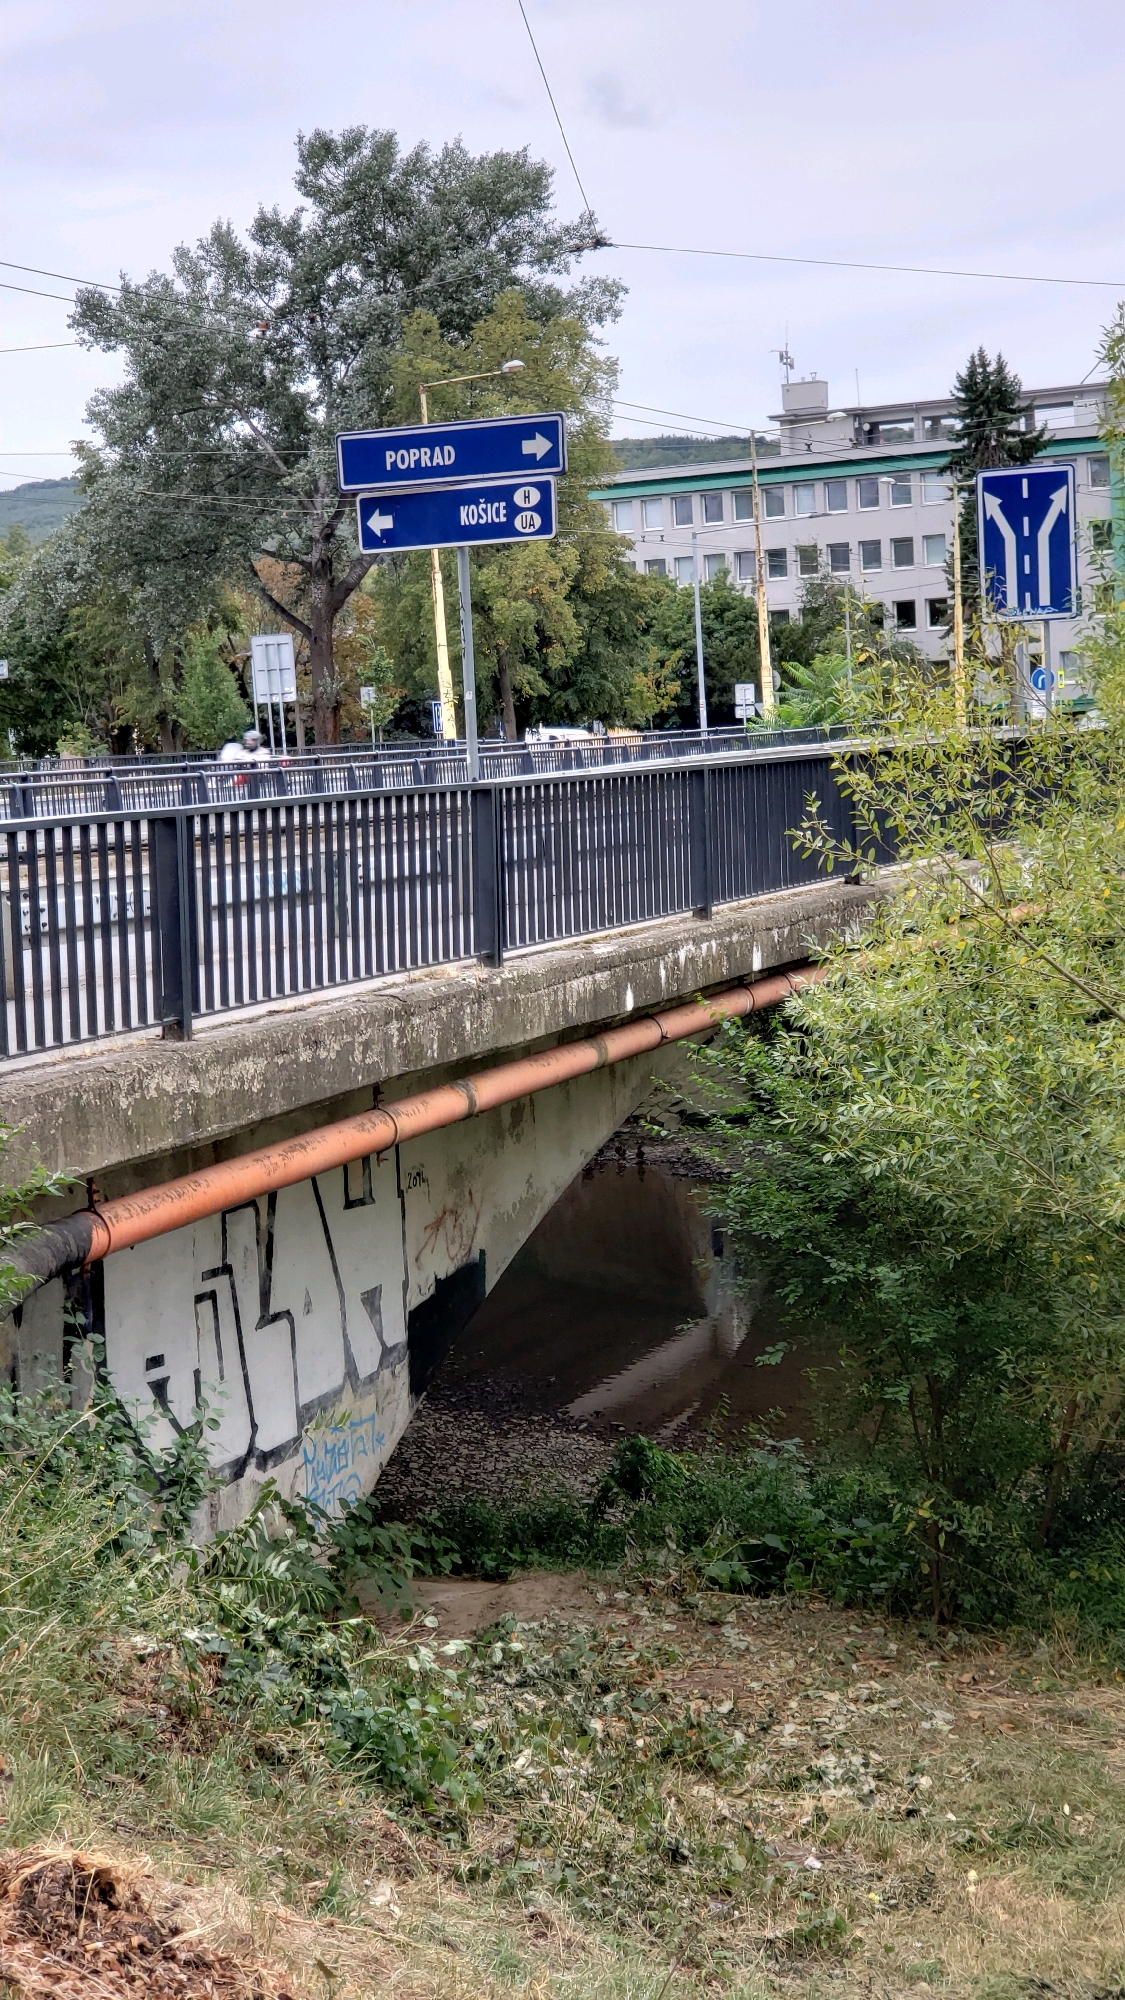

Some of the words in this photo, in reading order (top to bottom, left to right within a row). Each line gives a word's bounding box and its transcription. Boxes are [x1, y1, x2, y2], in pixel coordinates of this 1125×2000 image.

[386, 445, 456, 471] POPRAD
[523, 489, 531, 505] H
[460, 498, 507, 526] KOŠICE
[520, 514, 536, 530] UA
